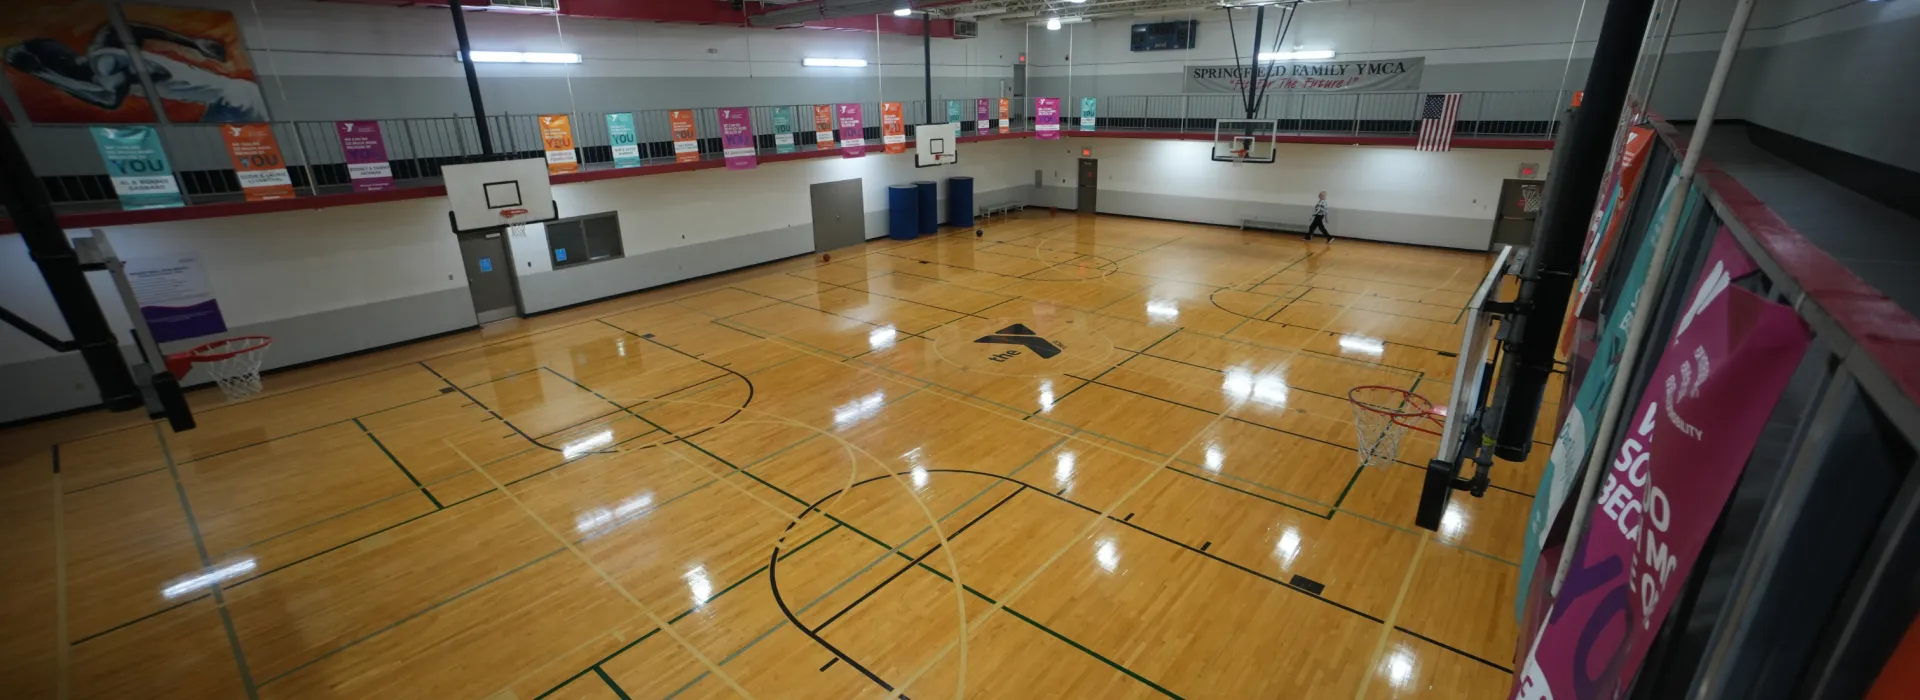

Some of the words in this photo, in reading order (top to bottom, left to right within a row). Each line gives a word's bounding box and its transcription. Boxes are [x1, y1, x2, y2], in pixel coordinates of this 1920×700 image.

[1193, 65, 1286, 79] SPRINGFELD
[1292, 63, 1350, 76] FAMILY
[1356, 61, 1406, 75] YMCA
[1279, 77, 1297, 89] The
[612, 133, 634, 145] YOU
[111, 159, 164, 174] YOU
[988, 349, 1021, 363] the
